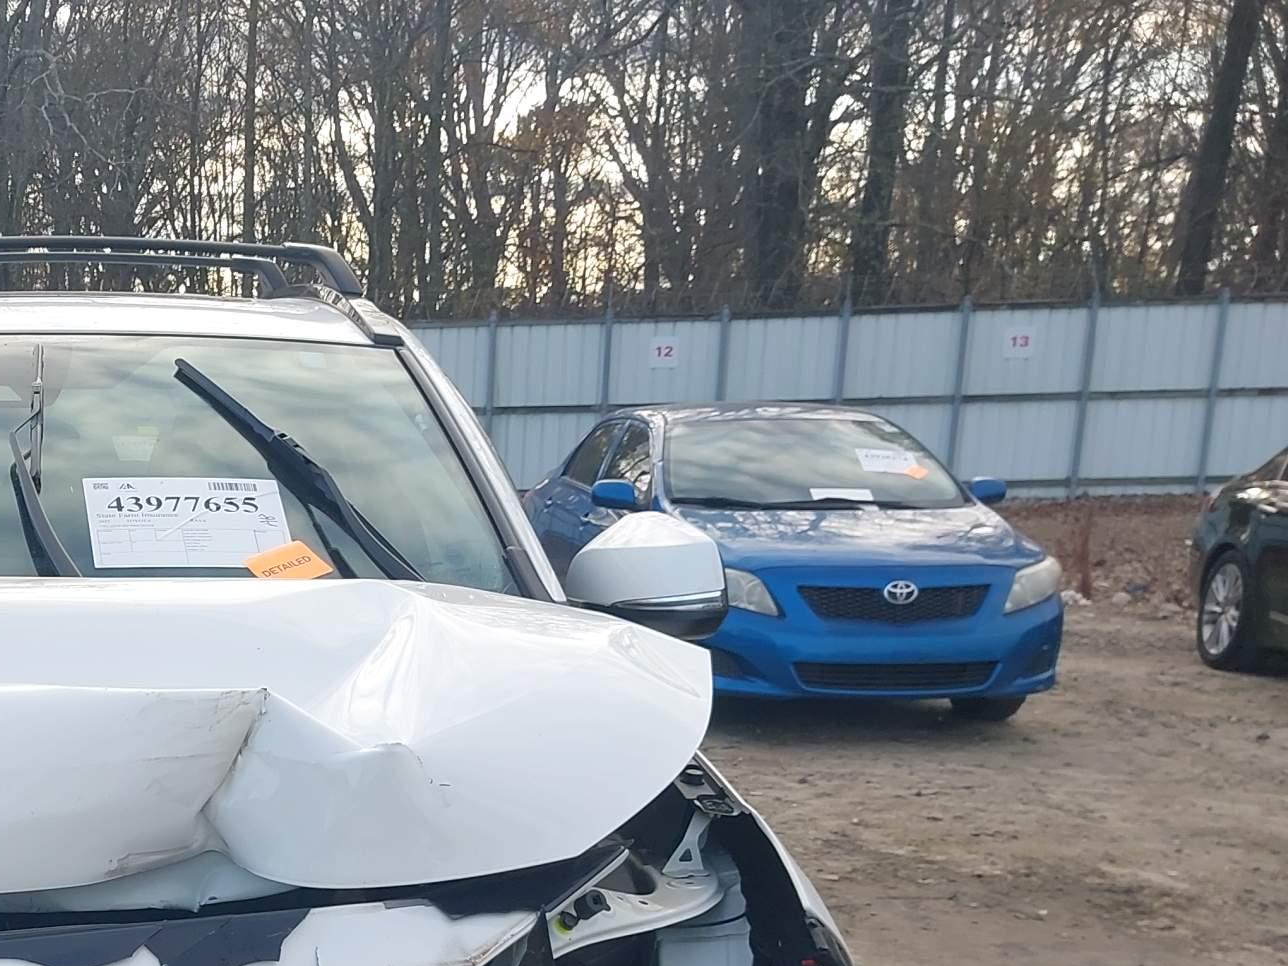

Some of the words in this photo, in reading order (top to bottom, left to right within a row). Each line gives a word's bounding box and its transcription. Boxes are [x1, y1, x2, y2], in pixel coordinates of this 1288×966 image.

[1011, 335, 1029, 348] 13
[655, 345, 673, 358] 12
[107, 495, 259, 514] 43977655
[261, 555, 312, 578] DETAILED
